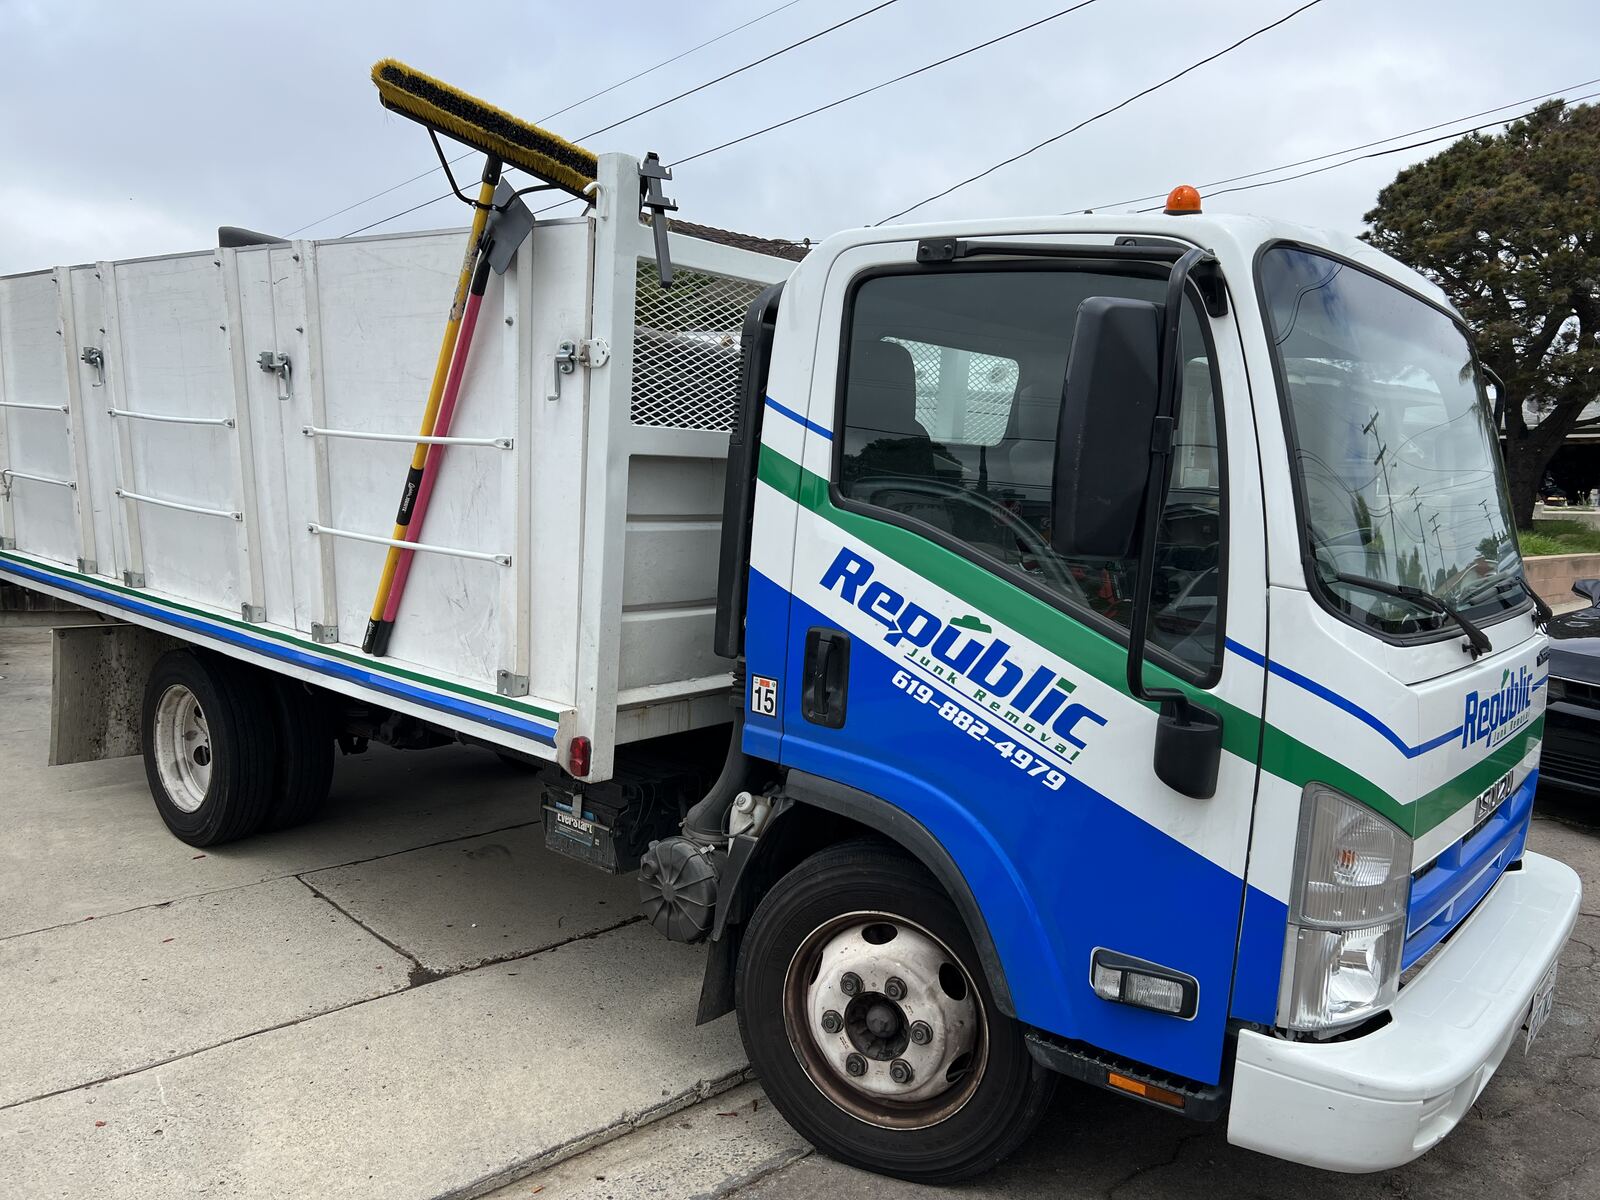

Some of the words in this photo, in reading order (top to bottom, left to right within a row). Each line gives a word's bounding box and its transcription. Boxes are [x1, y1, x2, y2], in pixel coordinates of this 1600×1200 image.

[819, 547, 1108, 749] Republic
[754, 686, 775, 714] 15
[891, 670, 1067, 791] 619-882-4979
[907, 648, 958, 685] Junk
[973, 688, 1081, 762] Removal
[1462, 665, 1533, 749] Republic
[1473, 769, 1514, 825] ISUZU
